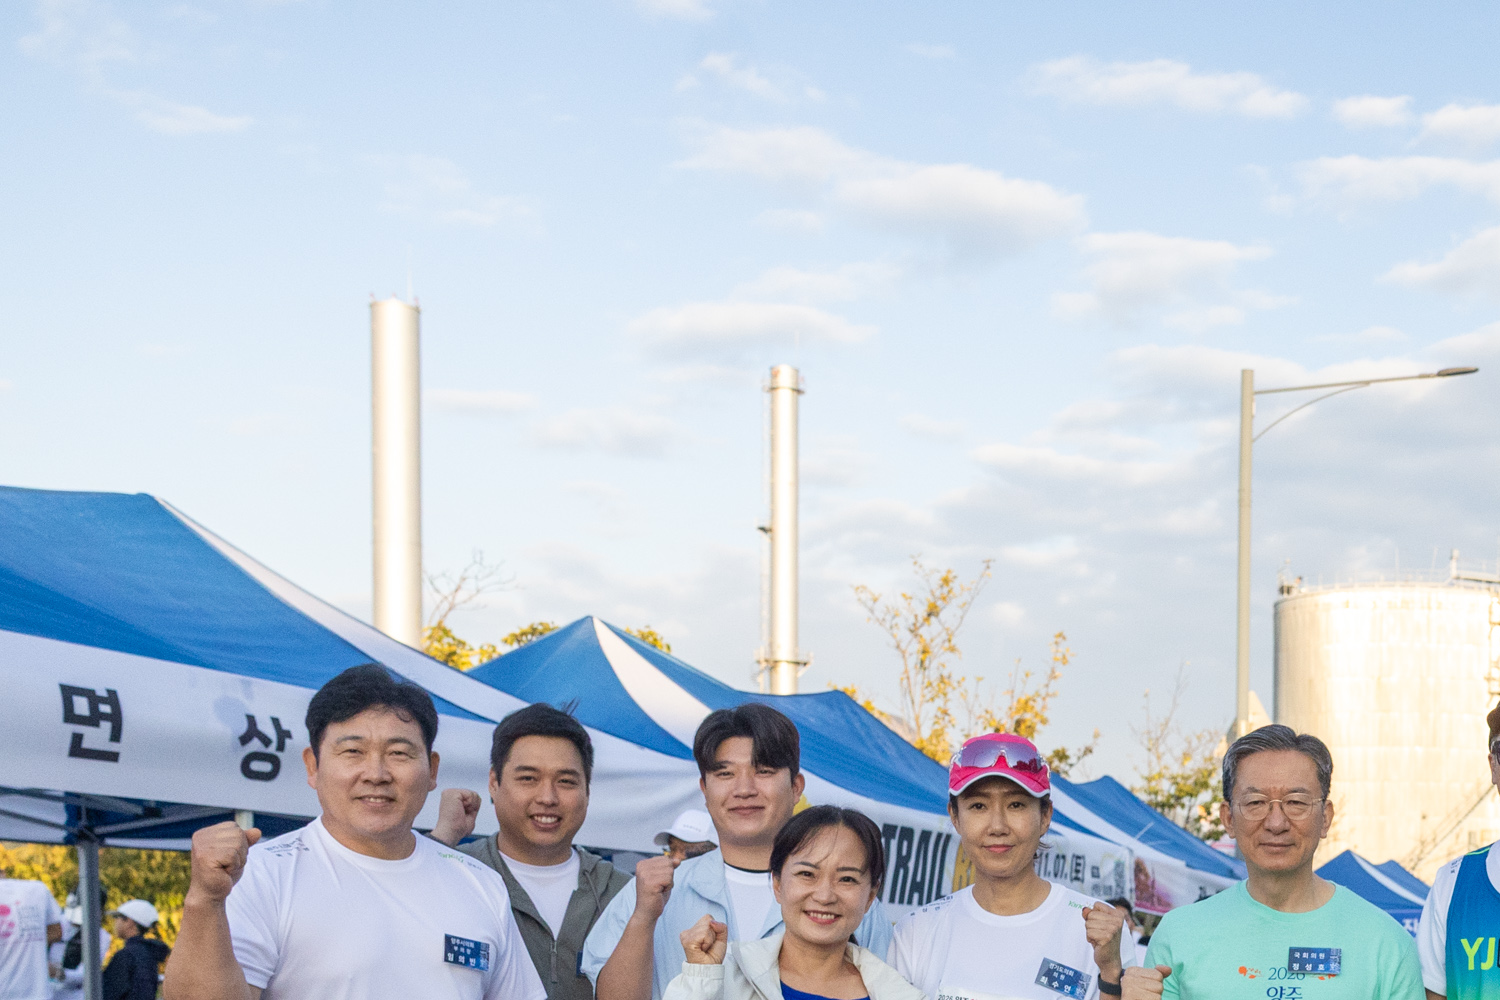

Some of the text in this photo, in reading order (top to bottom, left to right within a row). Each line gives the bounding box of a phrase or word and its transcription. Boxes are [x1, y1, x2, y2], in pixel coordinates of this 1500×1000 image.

[237, 713, 293, 782] 상
[878, 823, 952, 906] TRAIL
[1294, 952, 1325, 960] 국회의원
[1460, 937, 1496, 971] YJ
[1050, 962, 1075, 977] 경기도의회
[1292, 963, 1325, 971] 정성호
[1040, 975, 1071, 994] 최수연
